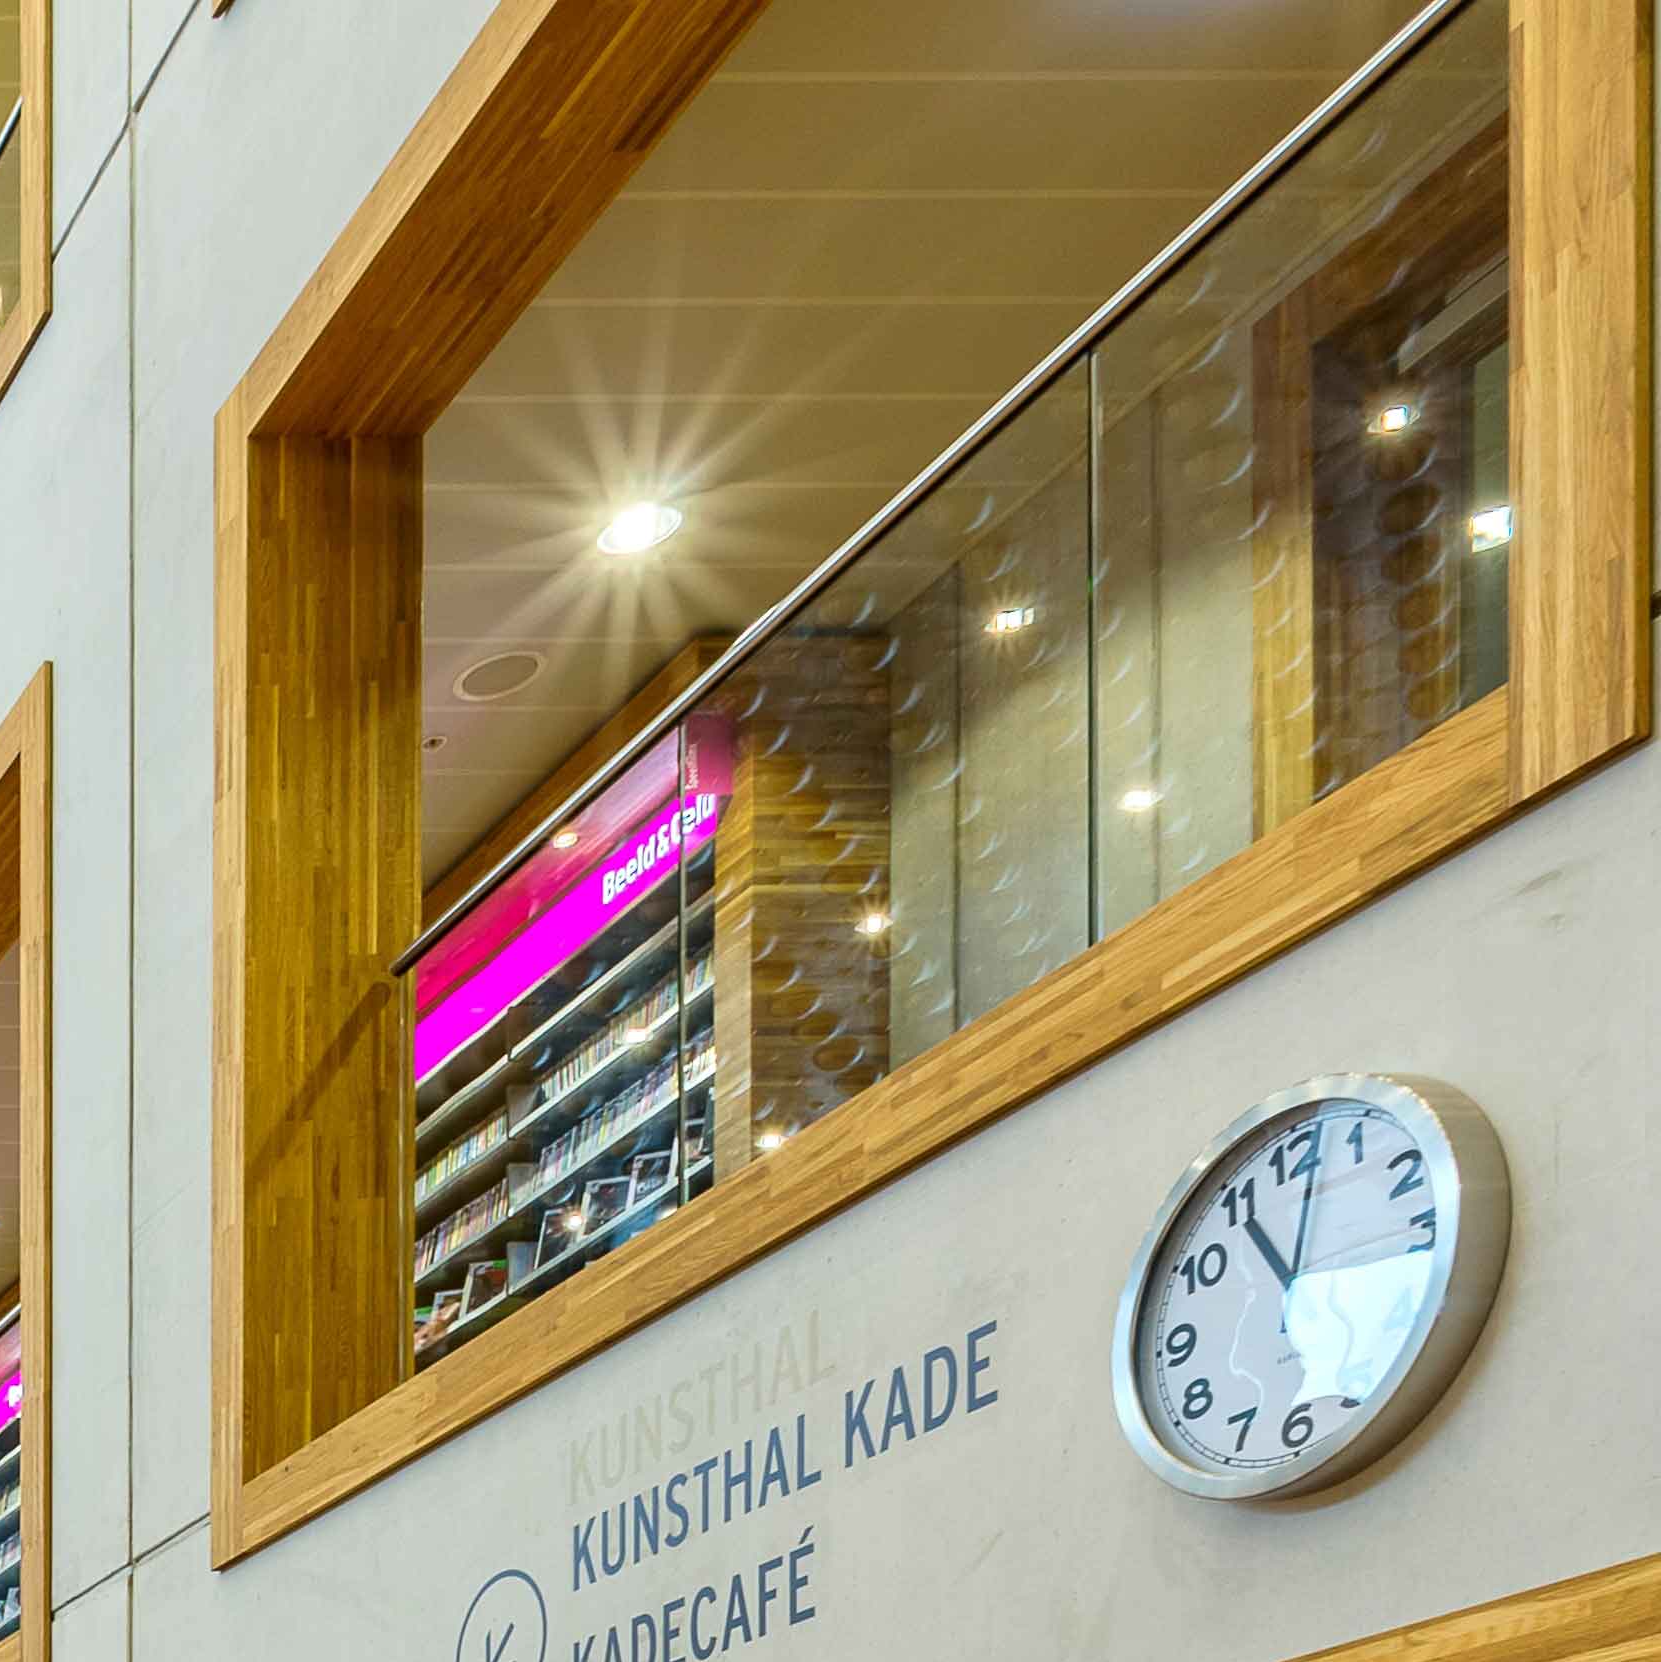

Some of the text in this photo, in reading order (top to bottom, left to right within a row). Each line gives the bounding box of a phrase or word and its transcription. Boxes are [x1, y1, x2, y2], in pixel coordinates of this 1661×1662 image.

[602, 833, 656, 904] Beeld
[1268, 1129, 1321, 1186] 12
[1346, 1121, 1364, 1164] 1
[1387, 1148, 1423, 1200] 2
[1221, 1177, 1256, 1227] 11
[1179, 1242, 1228, 1296] 10
[1166, 1323, 1197, 1367] 9
[1182, 1377, 1213, 1420] 8
[1227, 1407, 1258, 1452] 7
[1281, 1402, 1314, 1449] 6
[572, 1319, 1000, 1592] KUNSTHAL KADE
